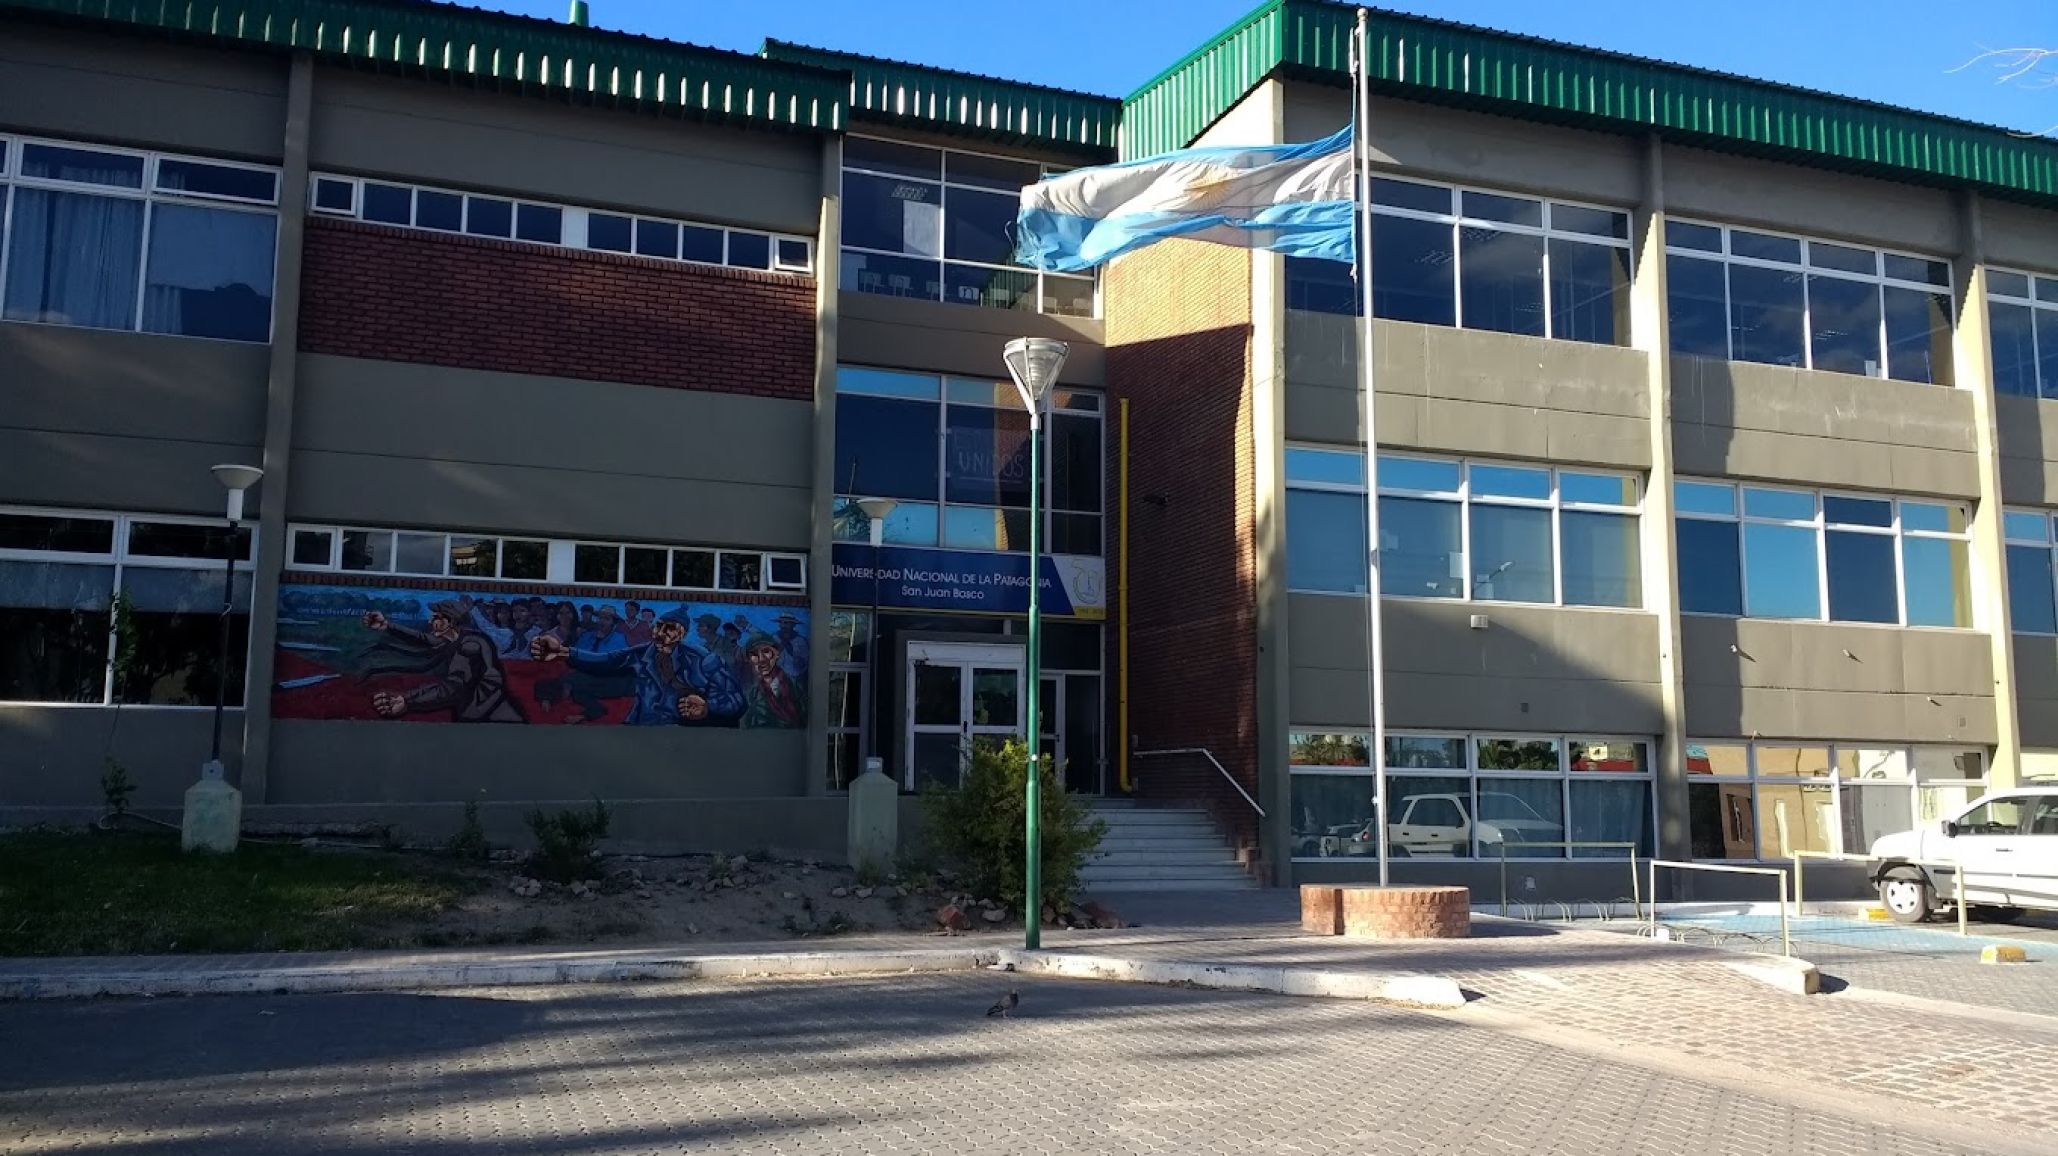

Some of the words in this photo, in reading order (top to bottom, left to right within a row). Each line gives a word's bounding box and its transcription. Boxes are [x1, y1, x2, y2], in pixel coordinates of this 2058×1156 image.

[831, 564, 901, 580] UNIVERSDAD
[903, 567, 960, 583] NACIONAL
[961, 573, 976, 584] DE
[978, 574, 991, 585] LA
[901, 584, 922, 596] San
[924, 587, 951, 598] Juan
[953, 588, 985, 599] Bosco
